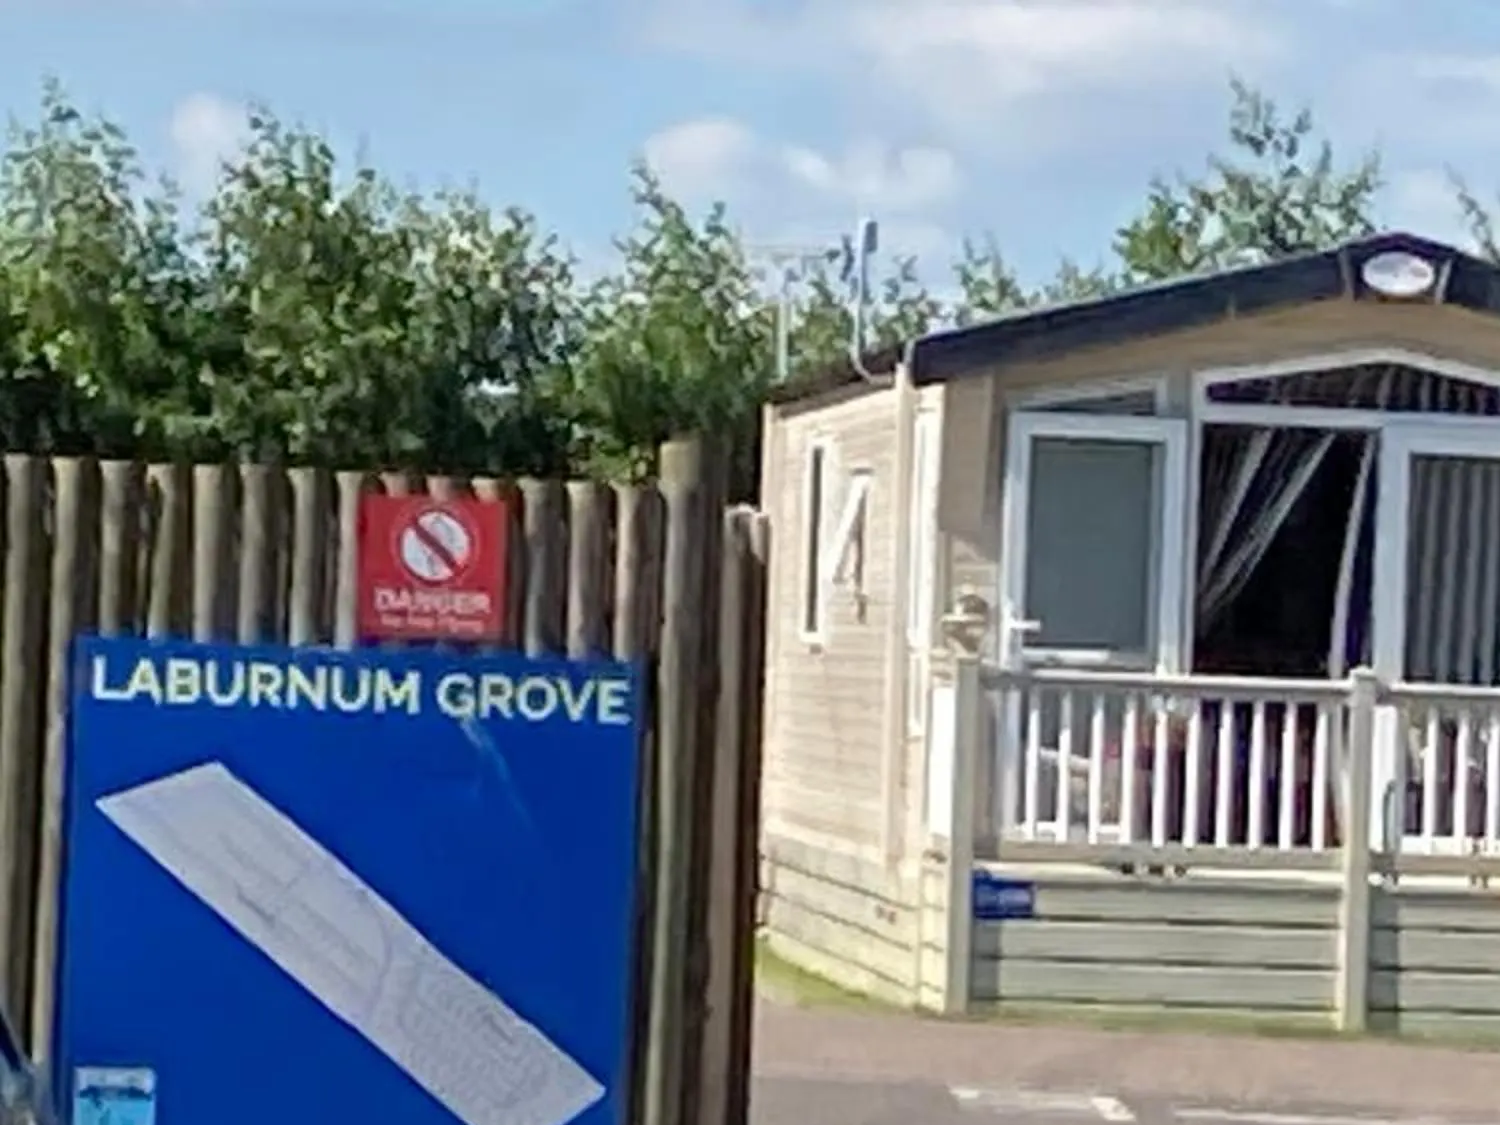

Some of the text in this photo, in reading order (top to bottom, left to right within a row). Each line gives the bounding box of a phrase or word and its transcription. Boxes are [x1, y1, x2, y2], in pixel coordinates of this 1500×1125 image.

[374, 587, 491, 614] DANGER
[93, 655, 632, 725] LABURNUM GROVE
